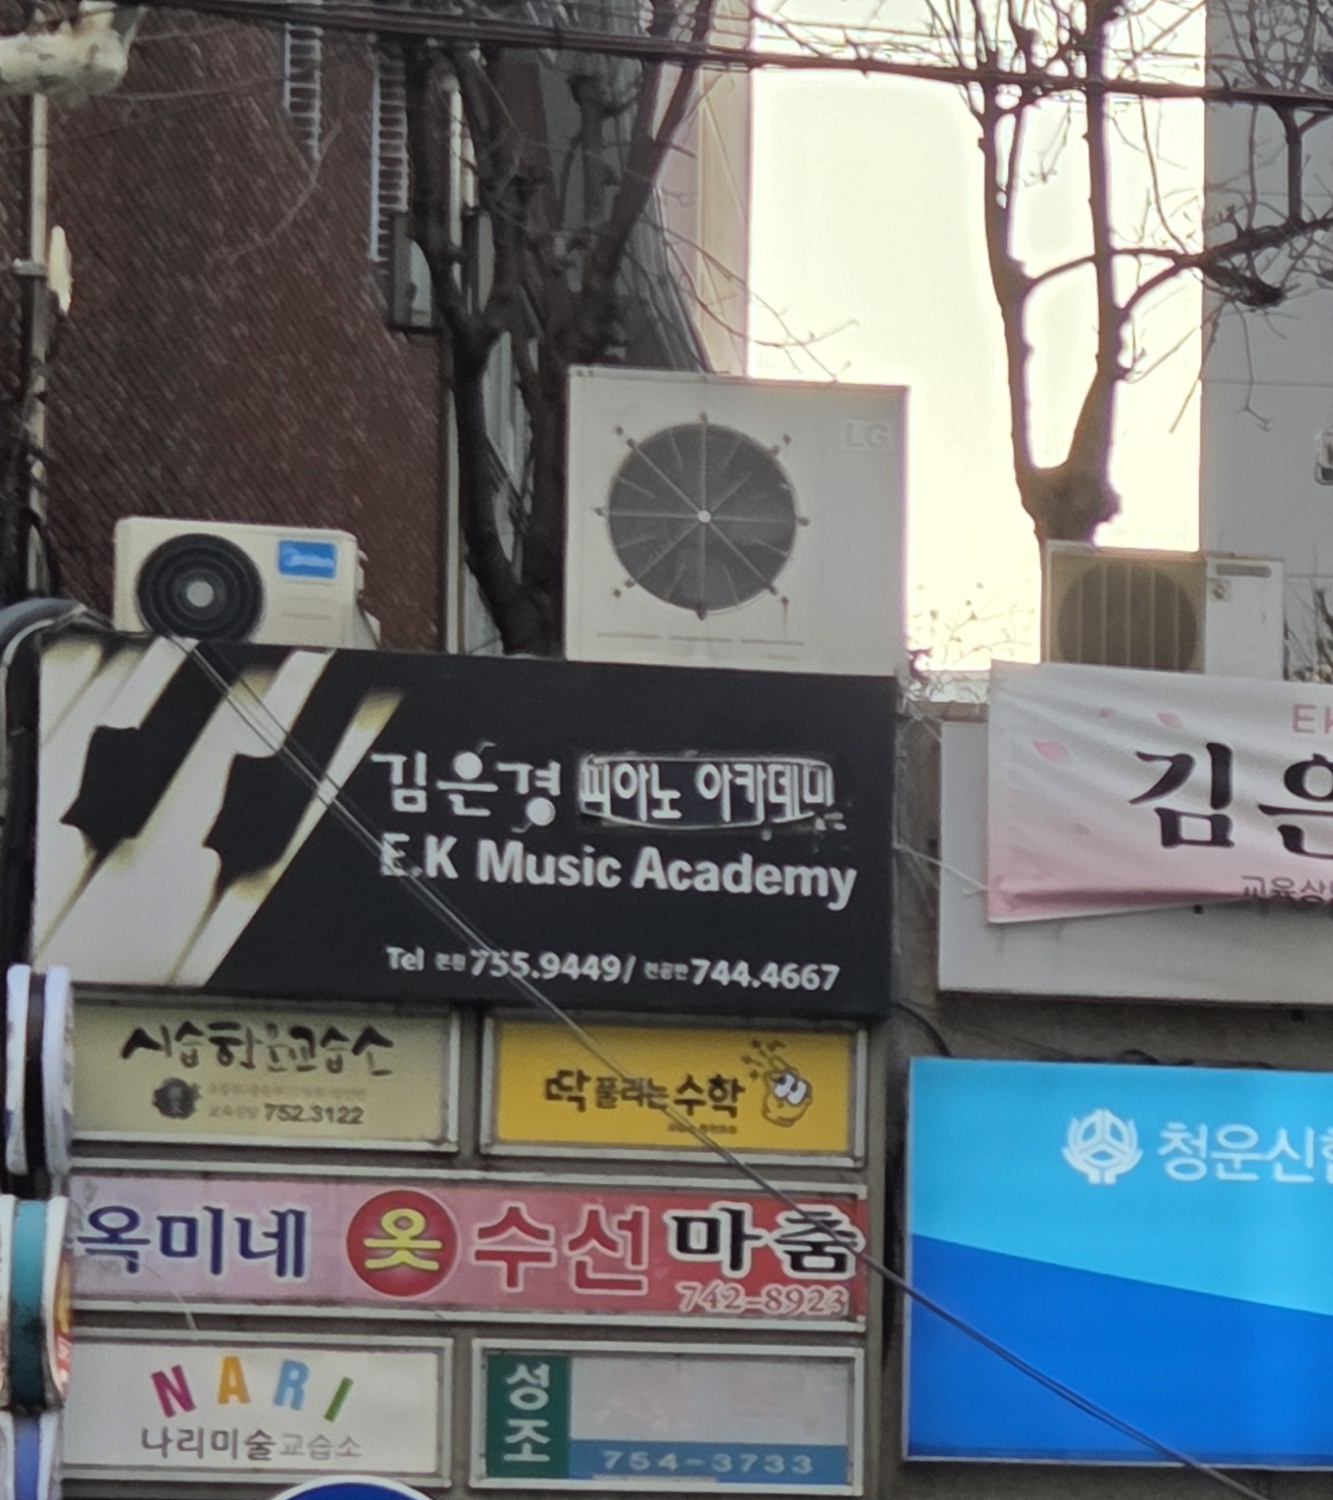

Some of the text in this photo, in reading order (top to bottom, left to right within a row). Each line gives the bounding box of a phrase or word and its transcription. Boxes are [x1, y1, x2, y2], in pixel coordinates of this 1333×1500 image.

[371, 741, 561, 834] 김은경
[476, 837, 621, 888] Music
[631, 846, 857, 911] Academy
[386, 945, 425, 972] Tel
[692, 957, 842, 991] 744.4667
[76, 1200, 866, 1297] 옥미네 옷 수선 마춤
[675, 1281, 851, 1316] 742-8923
[150, 1354, 355, 1423] NARI
[502, 1361, 552, 1464] 성조
[141, 1425, 363, 1463] 나리미술교습소
[602, 1447, 815, 1476] 754-3733
